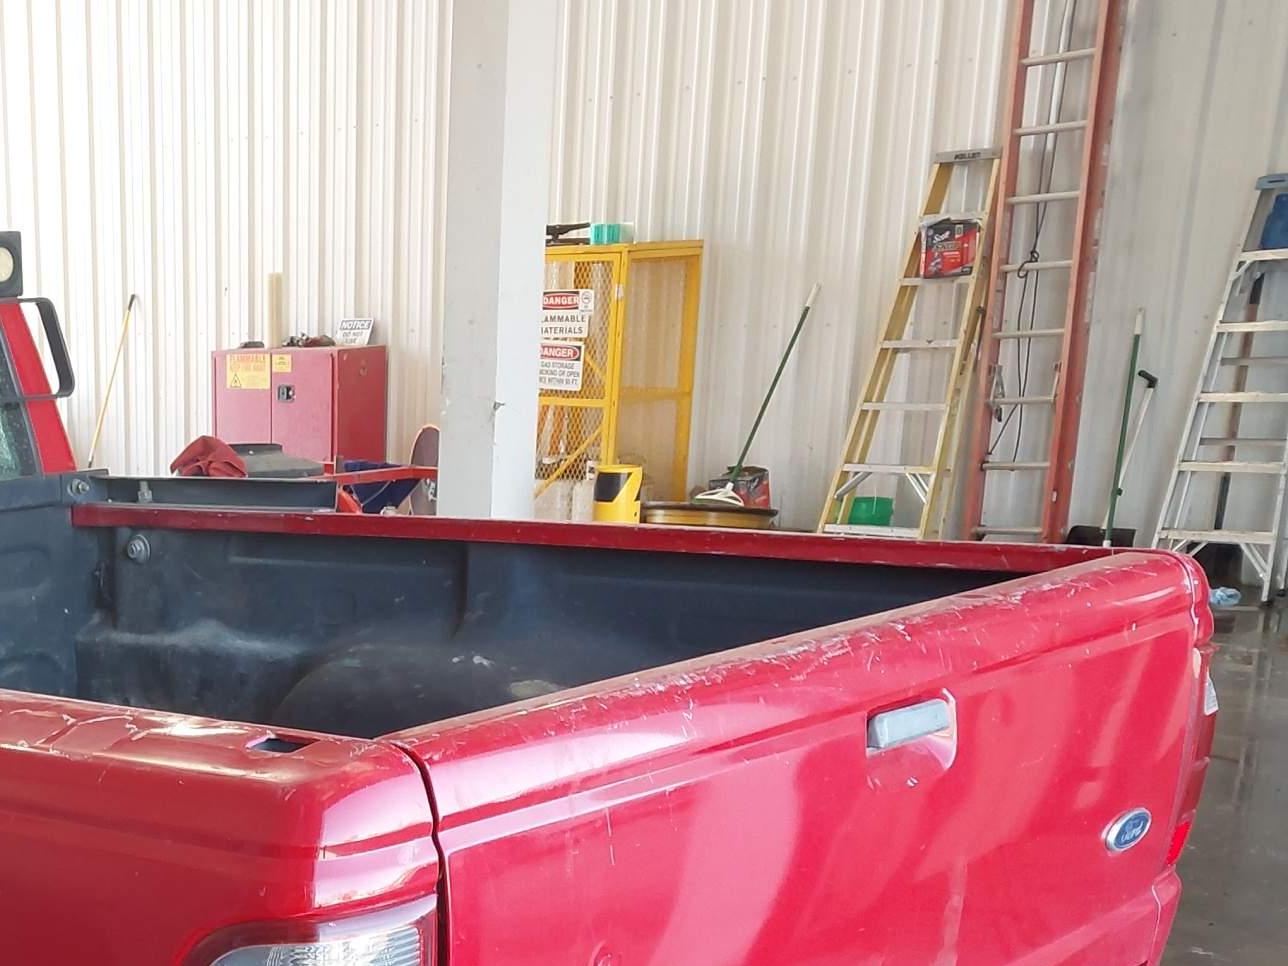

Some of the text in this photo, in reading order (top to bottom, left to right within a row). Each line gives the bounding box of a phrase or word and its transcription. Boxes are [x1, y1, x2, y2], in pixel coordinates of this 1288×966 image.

[543, 295, 579, 305] DANGER
[541, 314, 586, 323] AMMABLE
[342, 320, 371, 329] NOTICE
[540, 347, 574, 358] ANGER
